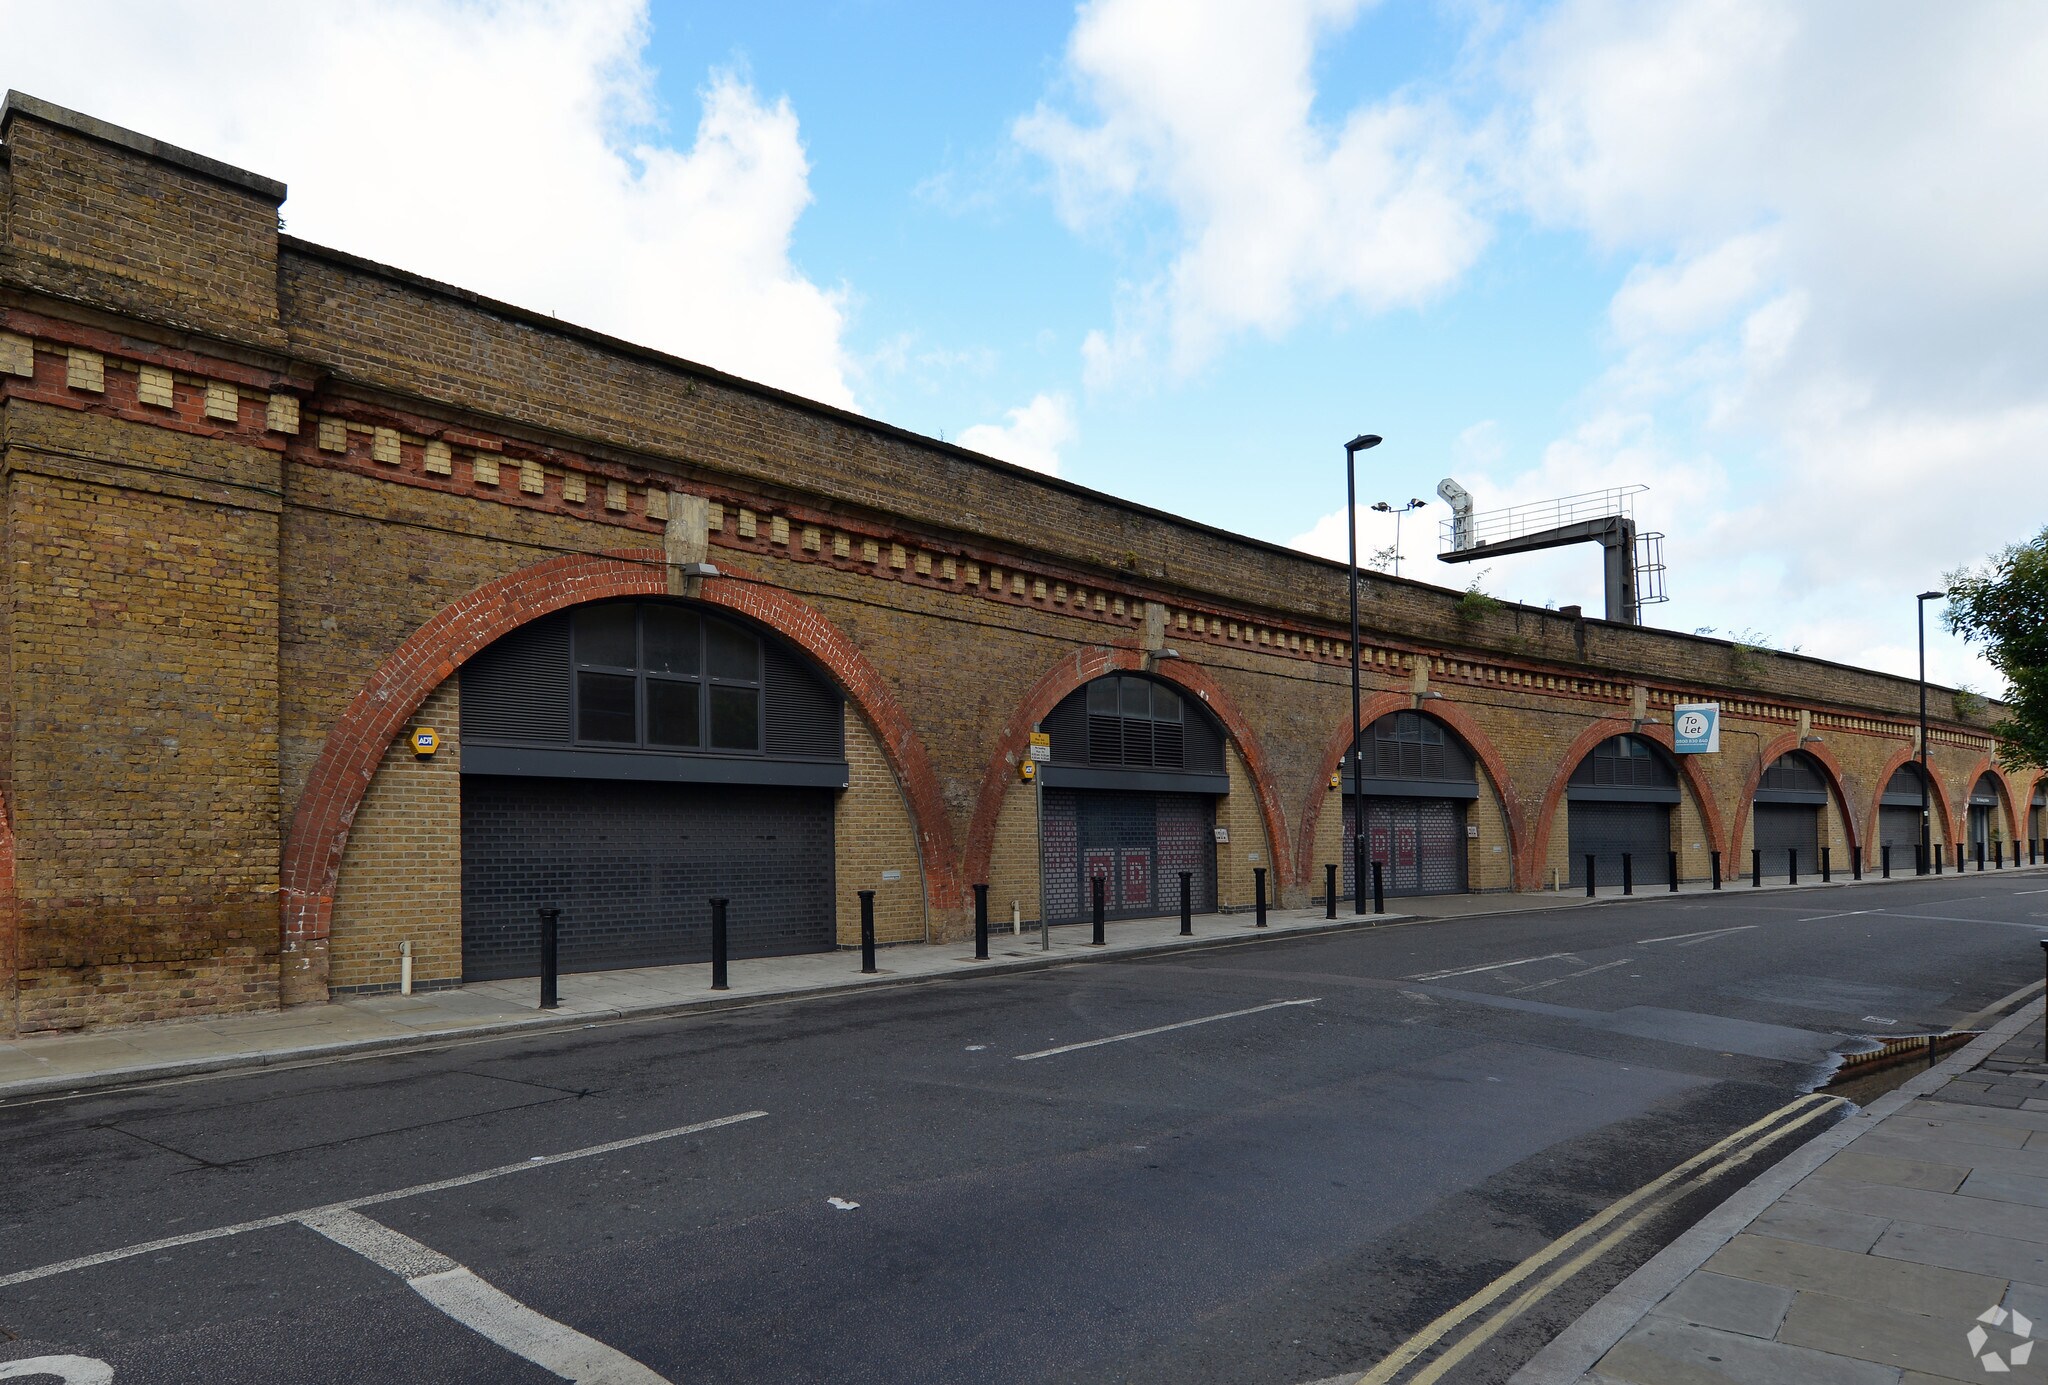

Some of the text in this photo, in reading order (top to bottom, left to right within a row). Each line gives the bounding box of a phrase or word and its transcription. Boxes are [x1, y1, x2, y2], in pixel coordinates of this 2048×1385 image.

[1685, 716, 1697, 725] To
[1684, 726, 1702, 734] Let
[418, 736, 432, 745] ADT
